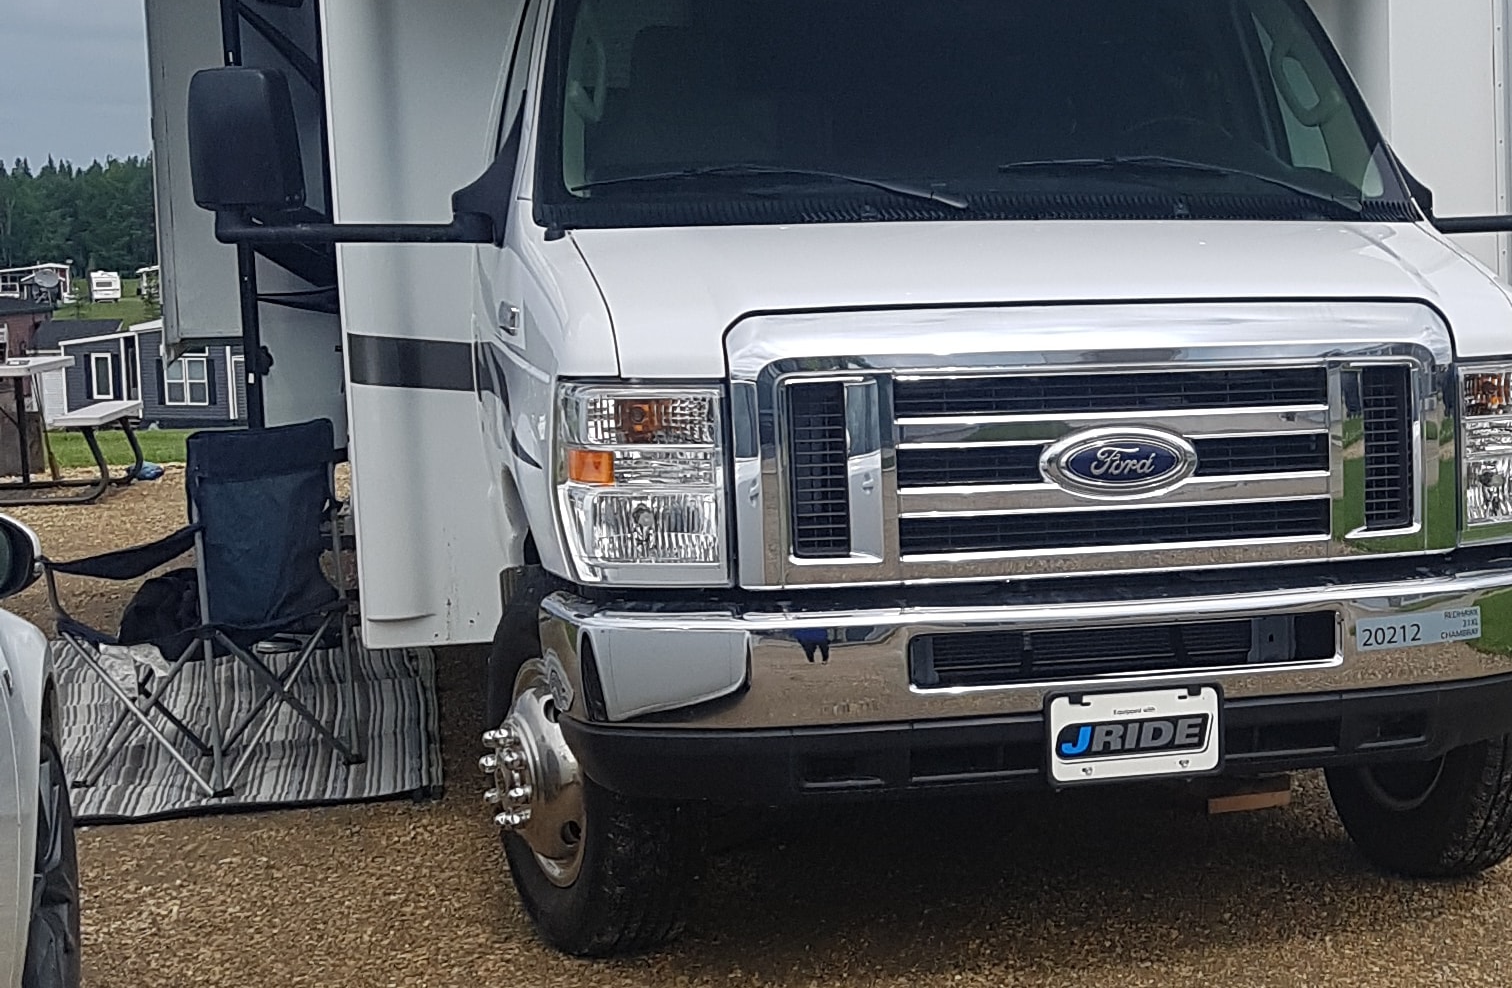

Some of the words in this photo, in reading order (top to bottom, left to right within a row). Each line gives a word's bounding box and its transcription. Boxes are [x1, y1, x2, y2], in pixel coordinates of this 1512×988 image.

[1090, 446, 1156, 476] Ford
[1362, 623, 1422, 647] 20212
[1060, 717, 1203, 756] JRIDE
